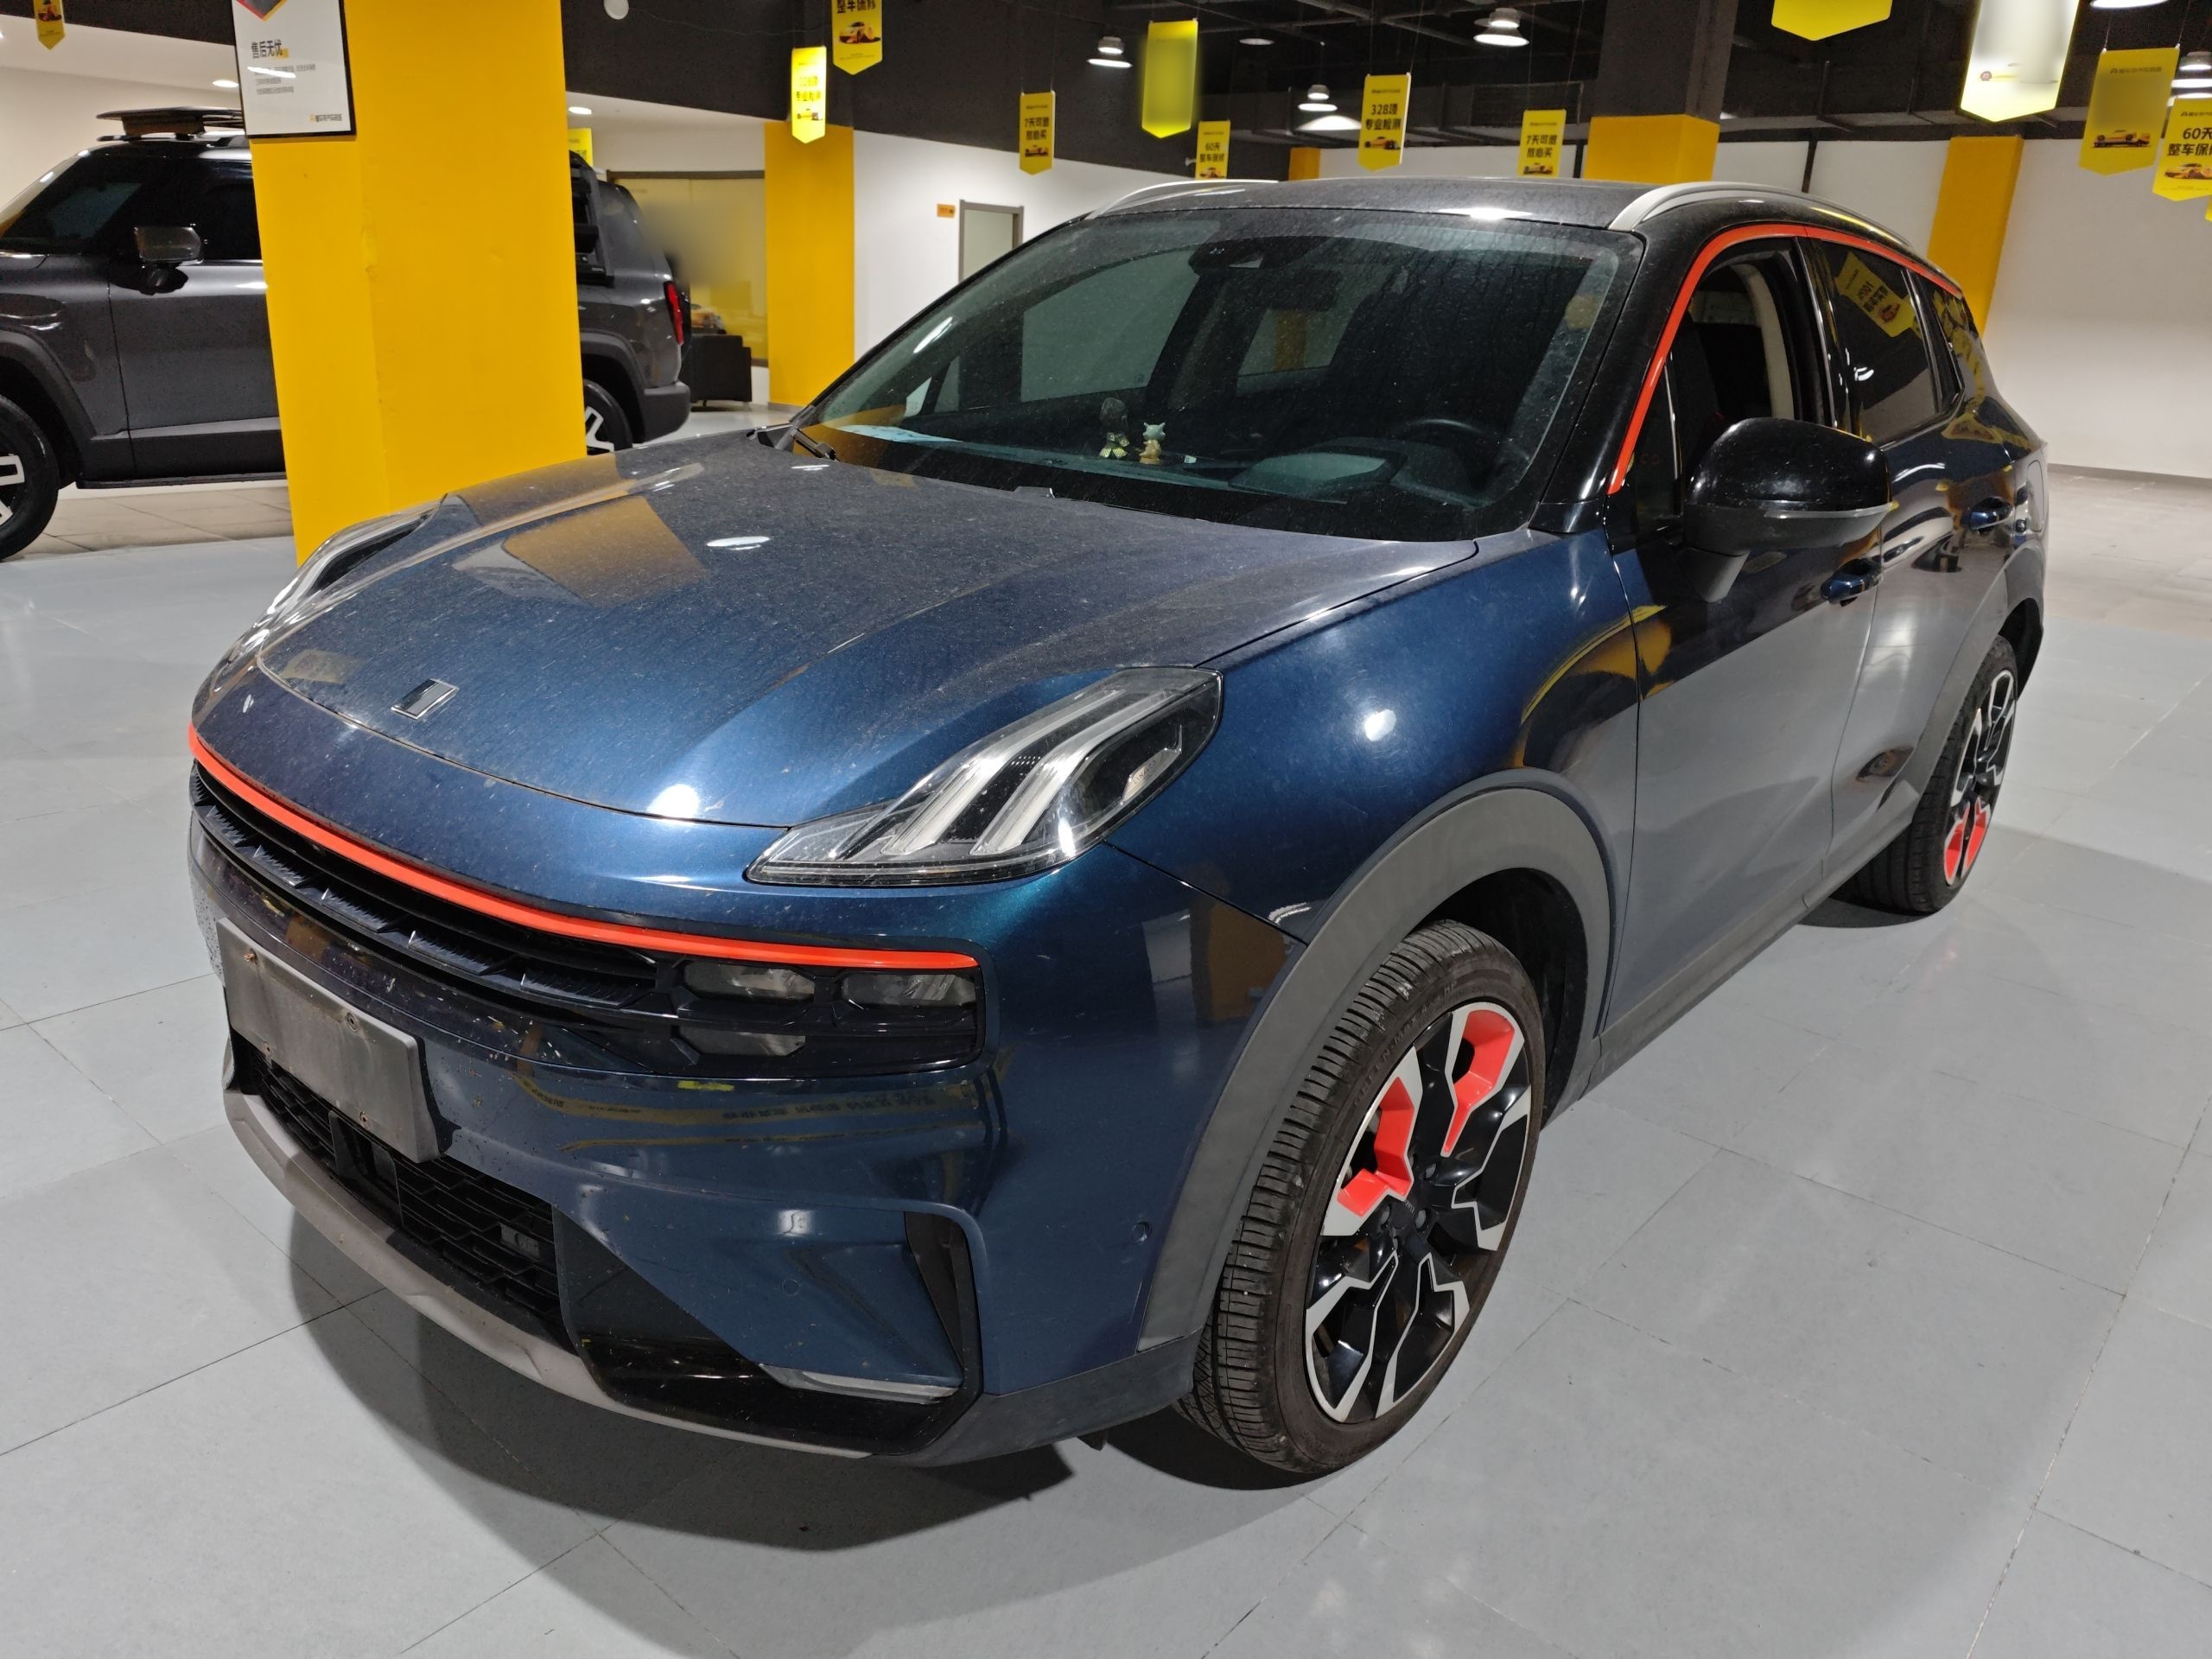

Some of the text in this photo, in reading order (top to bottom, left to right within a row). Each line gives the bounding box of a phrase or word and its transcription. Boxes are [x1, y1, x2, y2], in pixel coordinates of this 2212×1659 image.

[251, 39, 283, 59] 售后无忧
[2183, 127, 2212, 140] 60天
[2167, 143, 2212, 156] 整车保
